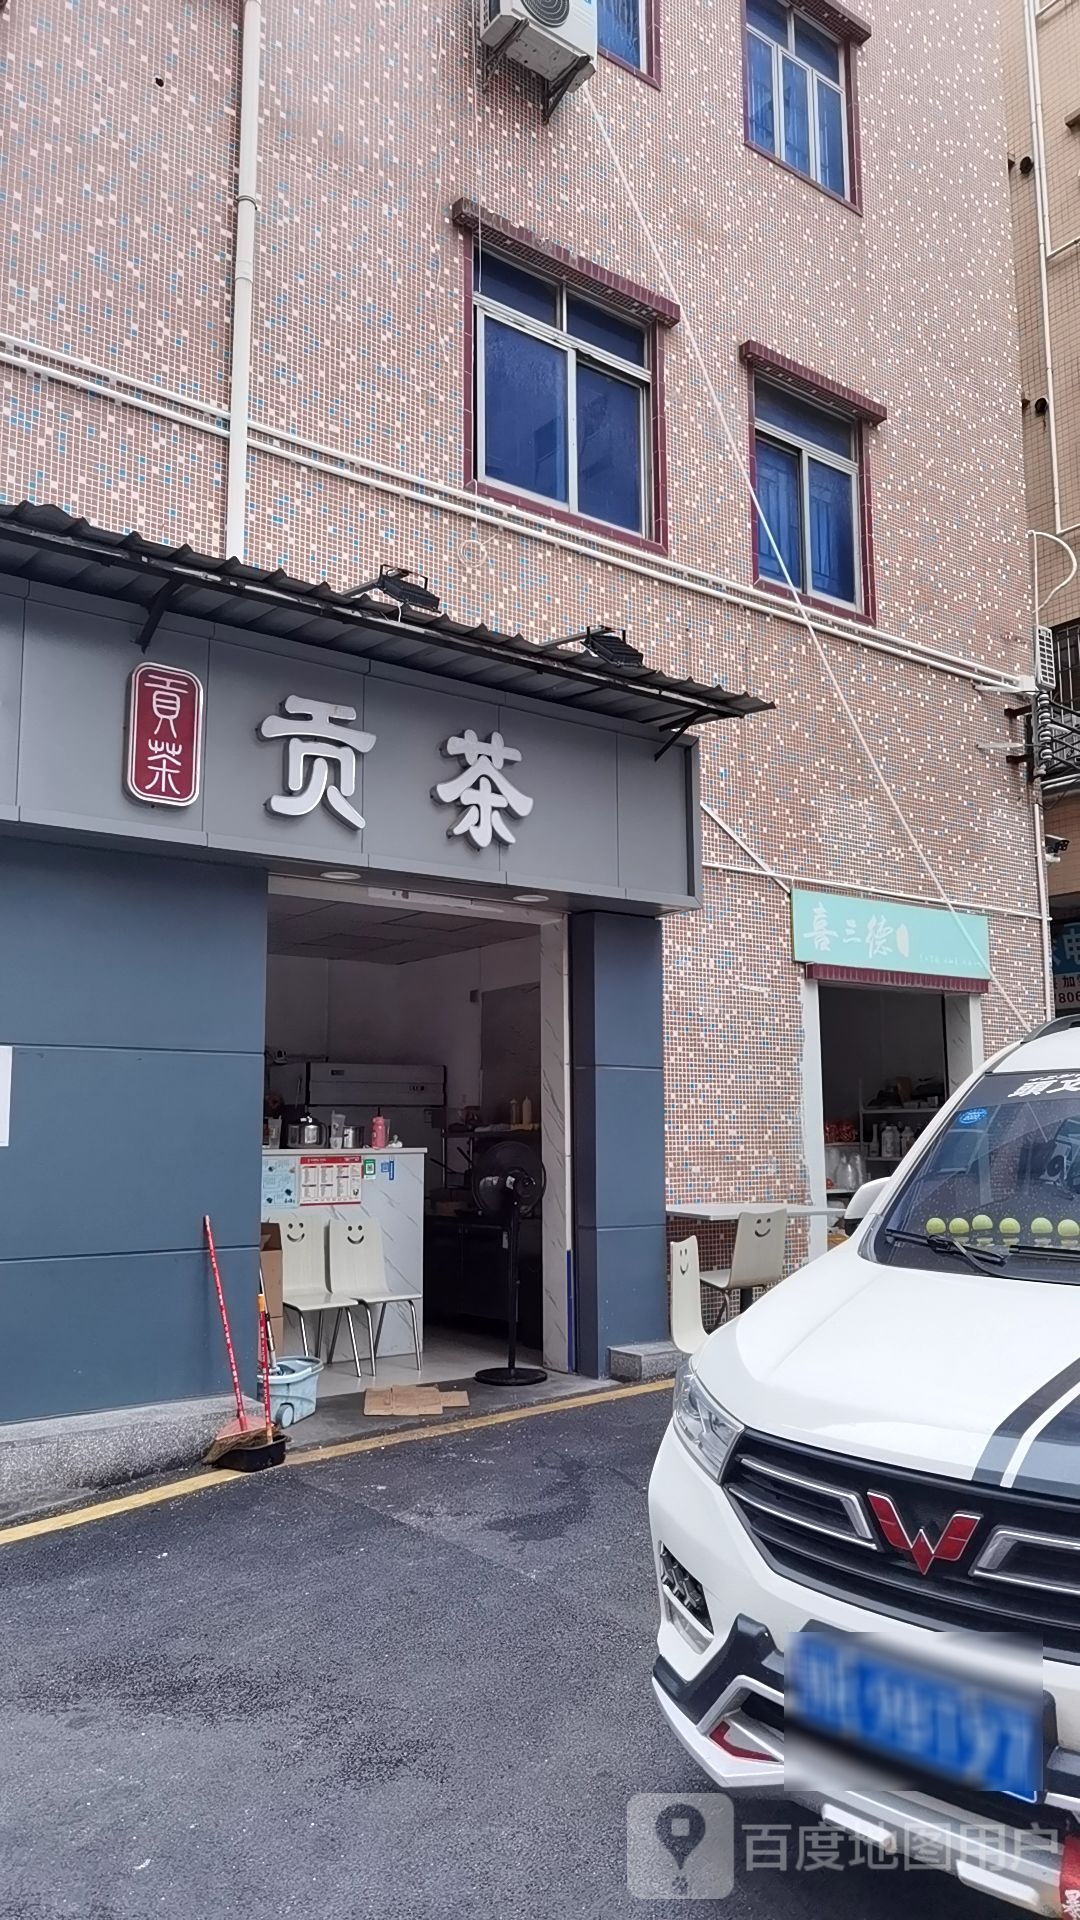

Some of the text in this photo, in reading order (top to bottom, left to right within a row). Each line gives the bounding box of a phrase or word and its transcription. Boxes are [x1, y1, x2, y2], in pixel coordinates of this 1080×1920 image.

[144, 674, 189, 795] 貢茶
[258, 694, 535, 850] 贡茶
[803, 901, 895, 959] 喜三德
